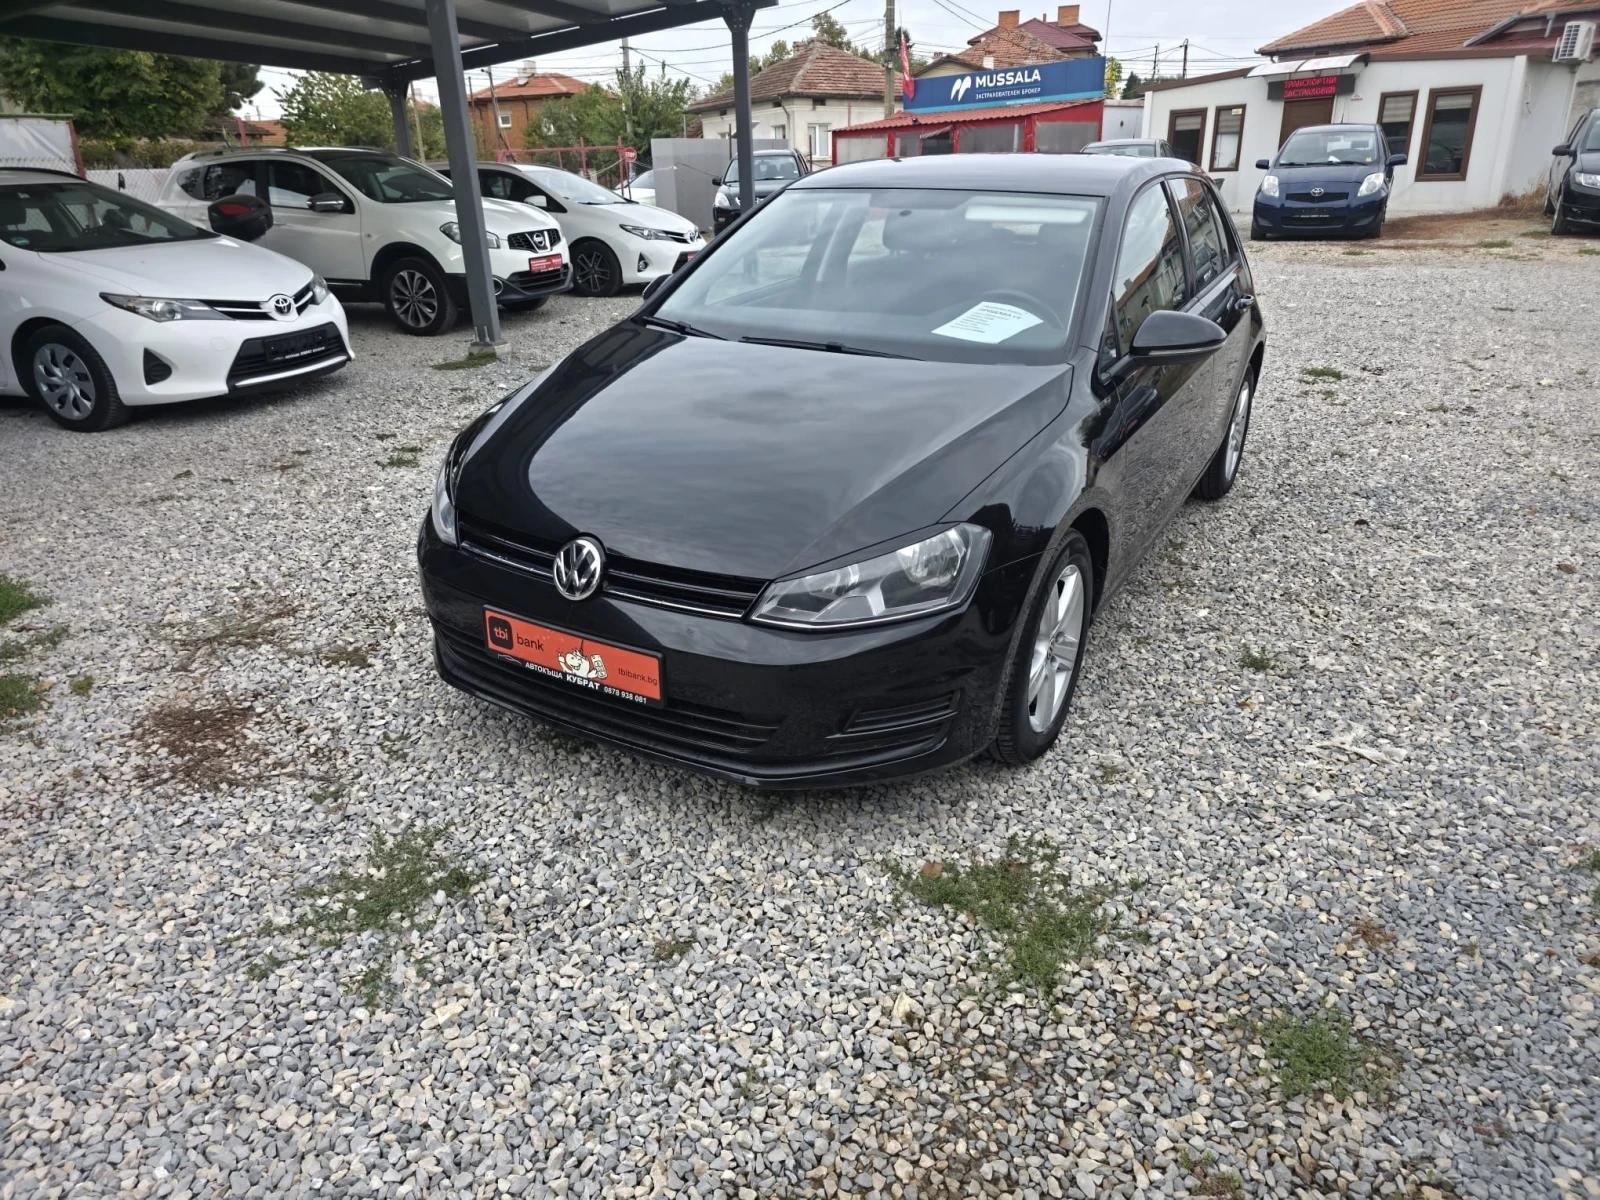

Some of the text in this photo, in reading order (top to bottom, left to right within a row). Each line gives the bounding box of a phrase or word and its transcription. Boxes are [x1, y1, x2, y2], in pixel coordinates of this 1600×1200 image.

[975, 69, 1041, 88] MUSSALA
[1284, 77, 1337, 88] ТРАНСПОРТНИ
[975, 87, 1041, 99] ЗАСТРАХОВАТЕЛЕН БРОКЕР
[1283, 86, 1336, 98] ЗАСТРАХОВКИ
[494, 626, 544, 652] tbi bank
[617, 667, 658, 686] tbibank.bg
[566, 674, 600, 690] КУБРАТ
[603, 686, 620, 697] 0878
[620, 690, 634, 700] 938
[634, 694, 647, 704] 081
